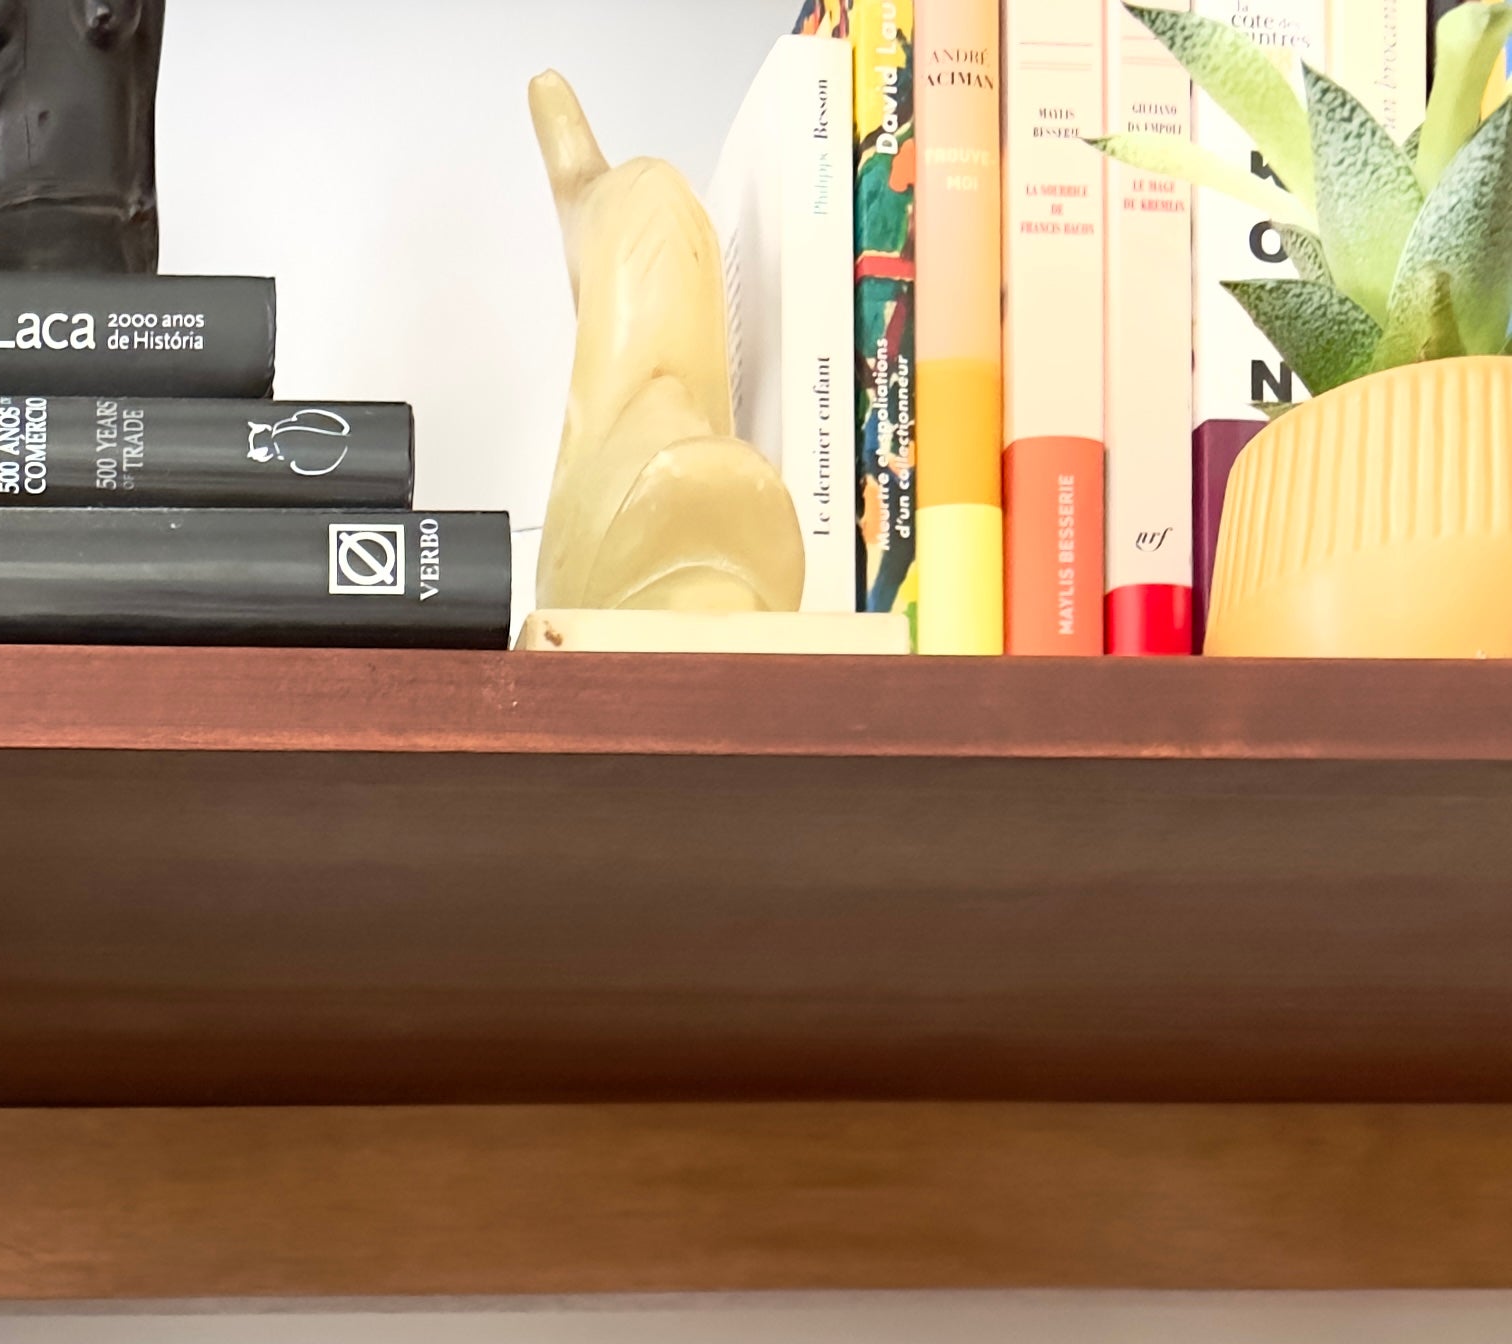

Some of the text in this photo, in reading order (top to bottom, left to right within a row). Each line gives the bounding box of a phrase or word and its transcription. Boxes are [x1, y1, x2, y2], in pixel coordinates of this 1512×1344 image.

[1242, 31, 1311, 49] intres
[929, 48, 991, 66] ANDRÉ
[925, 71, 994, 90] ACIMAN
[813, 79, 829, 139] Besson
[874, 66, 899, 155] David
[1038, 108, 1076, 120] MAYLIS
[1131, 103, 1178, 116] GIULIANO
[1033, 126, 1080, 138] BESSERIE
[1127, 121, 1141, 134] DA
[946, 175, 979, 192] MOI
[1026, 183, 1038, 197] LA
[1133, 179, 1176, 194] LE MAGE
[1140, 199, 1186, 213] KREMLIN
[1020, 221, 1095, 236] FRANCIS BACON
[106, 312, 205, 330] 2000 anos
[106, 329, 205, 352] de História
[872, 338, 892, 447] spoliations
[21, 396, 48, 495] COMÉRCIO
[95, 399, 118, 491] 500 YEARS
[122, 409, 145, 491] OF TRADE
[813, 356, 830, 535] Le dernier enfant
[895, 354, 911, 539] d'un collectionneur
[876, 472, 890, 551] Meurtre
[1135, 526, 1174, 552] nrf
[419, 518, 440, 601] VERBO
[1057, 473, 1076, 636] MAYLIS BESSERIE
